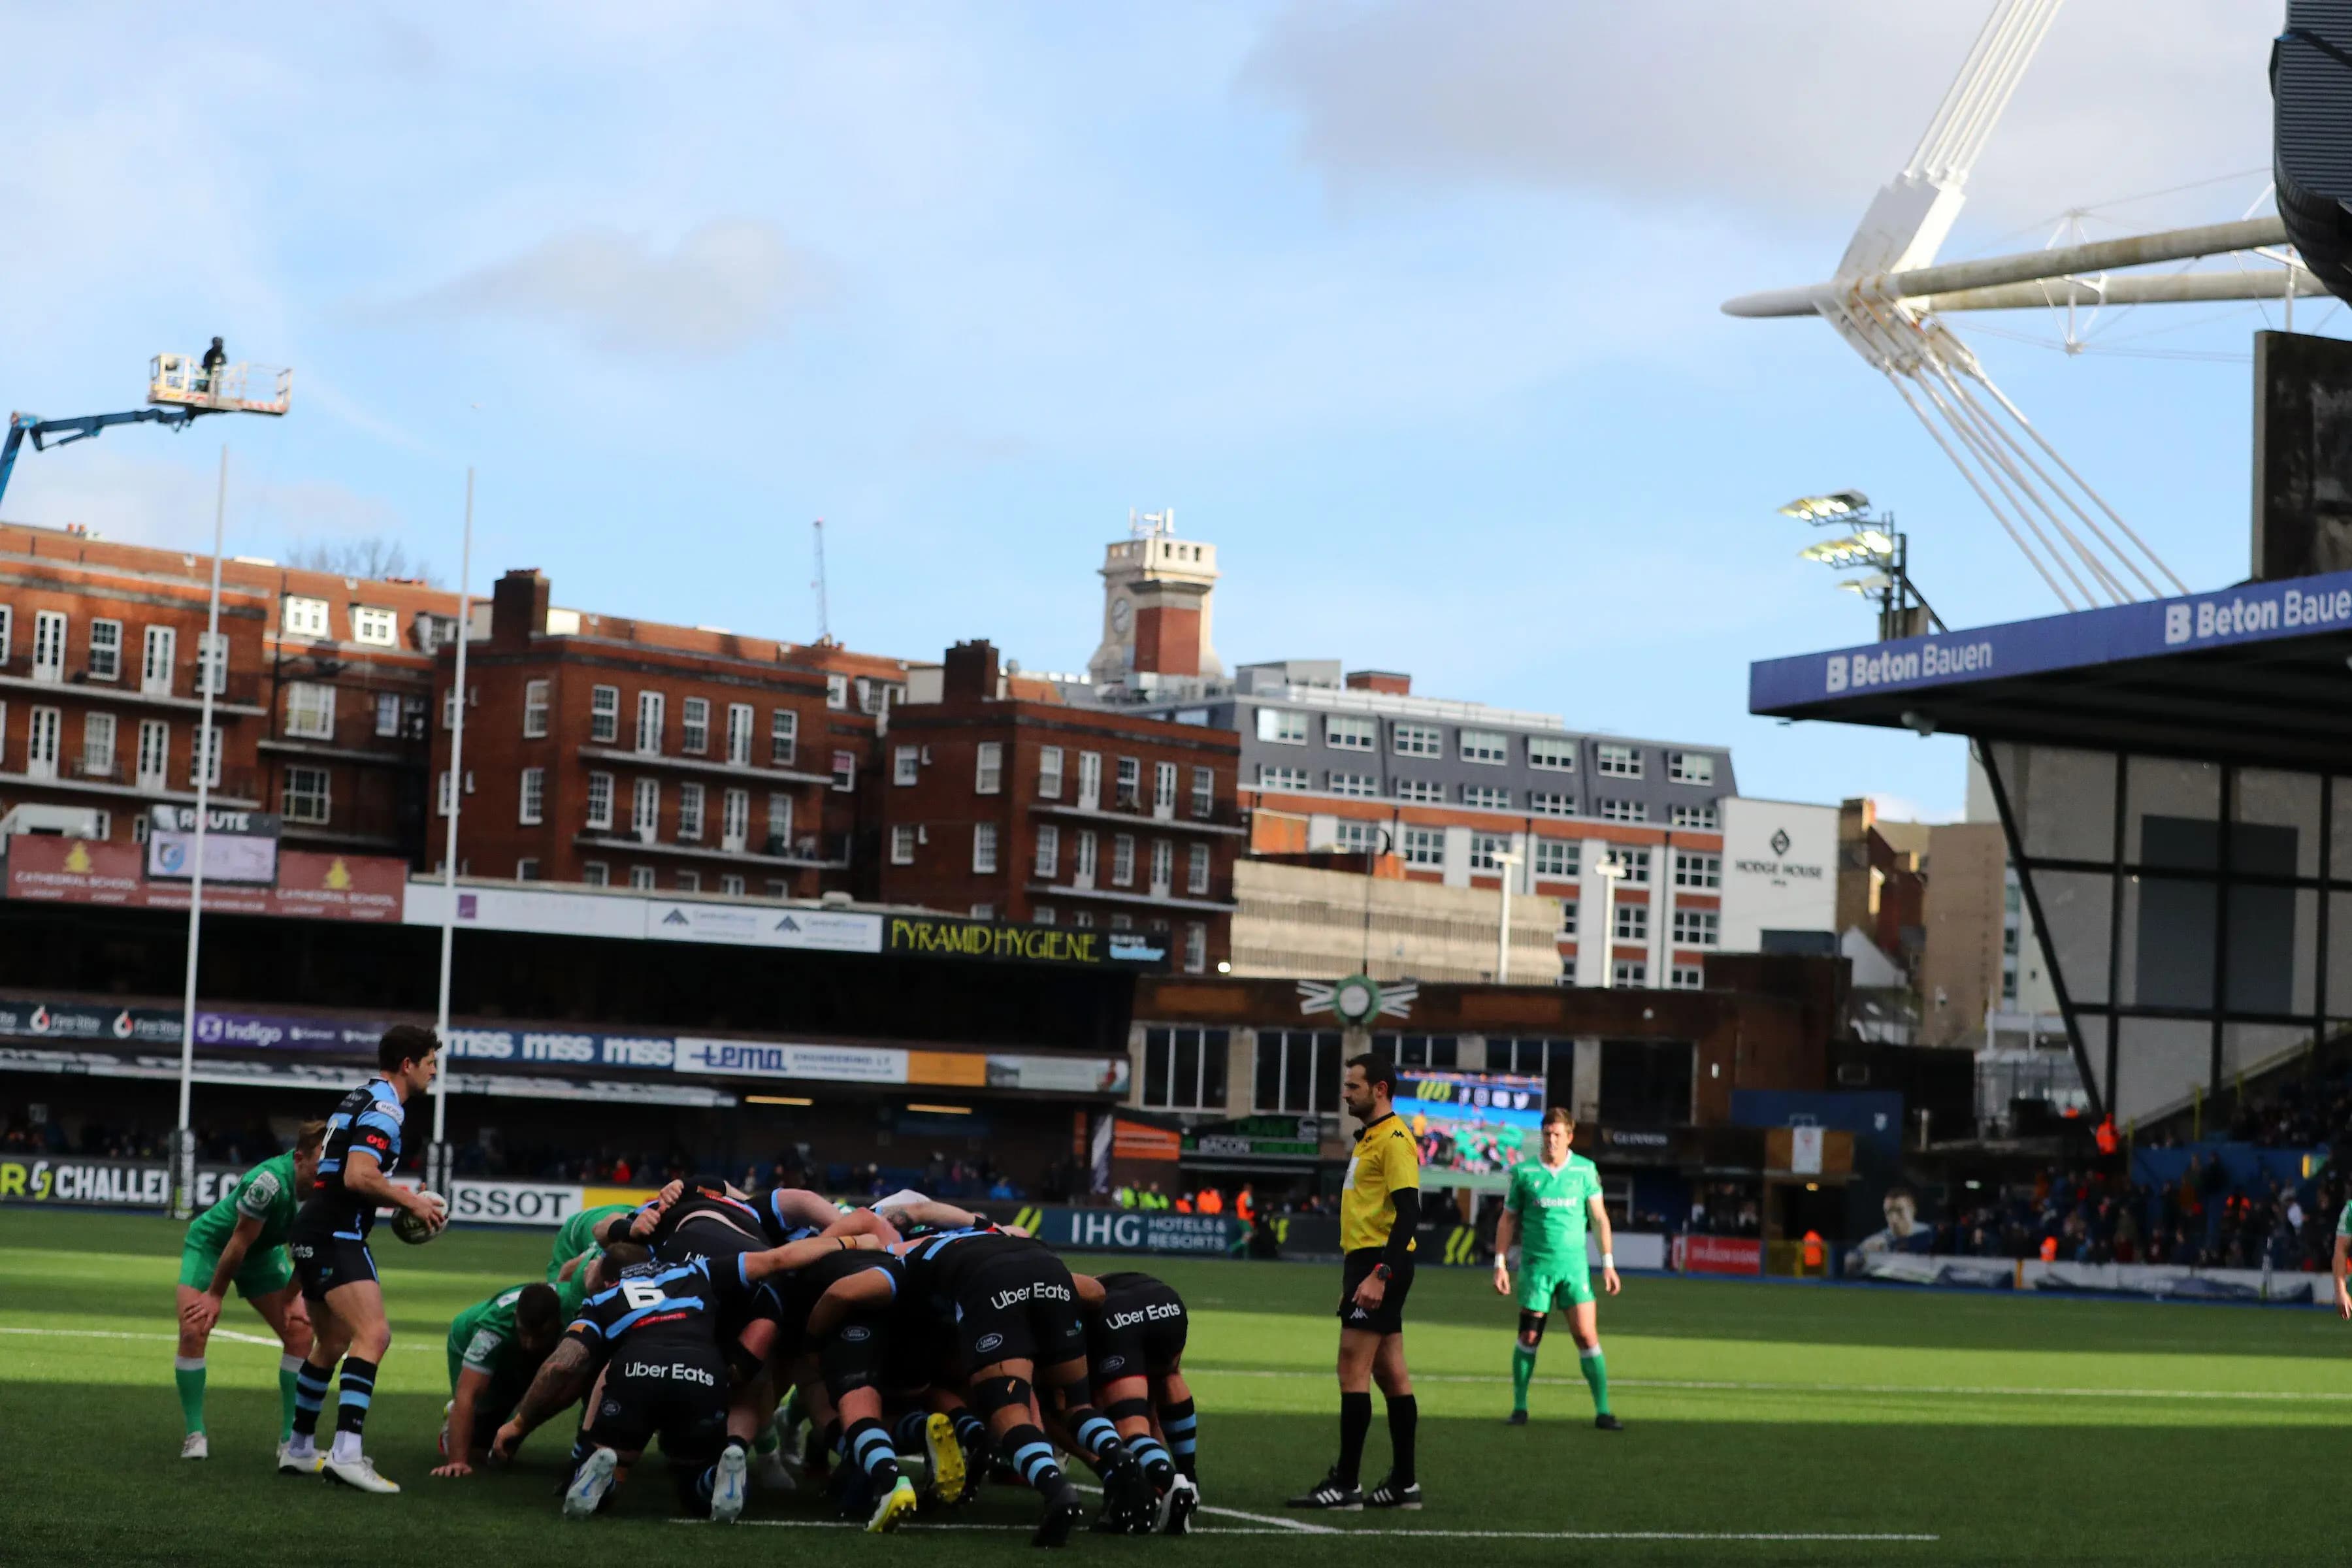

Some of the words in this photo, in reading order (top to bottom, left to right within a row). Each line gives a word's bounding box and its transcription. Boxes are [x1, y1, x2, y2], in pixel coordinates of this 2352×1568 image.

[2197, 596, 2279, 638] Beton
[1852, 650, 1919, 687] Beton
[1923, 642, 1992, 677] Bauen
[15, 871, 87, 887] CATHEDRAL
[89, 875, 138, 891] SCHOOL
[1736, 860, 1778, 875] HODGE
[1782, 864, 1823, 879] HOUSE
[275, 889, 346, 904] CATHEDRAL
[348, 892, 397, 907] SCHOOL
[891, 919, 992, 955] PYRAMID
[994, 926, 1100, 963] HYGIENE
[225, 1019, 282, 1047] Indigo
[523, 1033, 595, 1062] mss
[603, 1037, 674, 1066] mss
[1198, 1136, 1250, 1155] BACON
[1613, 1131, 1668, 1145] GUINNESS
[55, 1165, 217, 1207] CHALLEE
[448, 1188, 570, 1218] ISSOT
[1071, 1213, 1141, 1247] IHG
[1148, 1217, 1213, 1233] HOTELS
[1215, 1219, 1227, 1234] &
[1147, 1232, 1226, 1250] RESORTS
[623, 1281, 665, 1310] 6
[990, 1287, 1030, 1310] Uber
[1033, 1282, 1071, 1301] Eats
[1105, 1310, 1144, 1330] Uber
[1145, 1302, 1181, 1321] Eats
[625, 1361, 668, 1379] Uber
[672, 1363, 714, 1386] Eats
